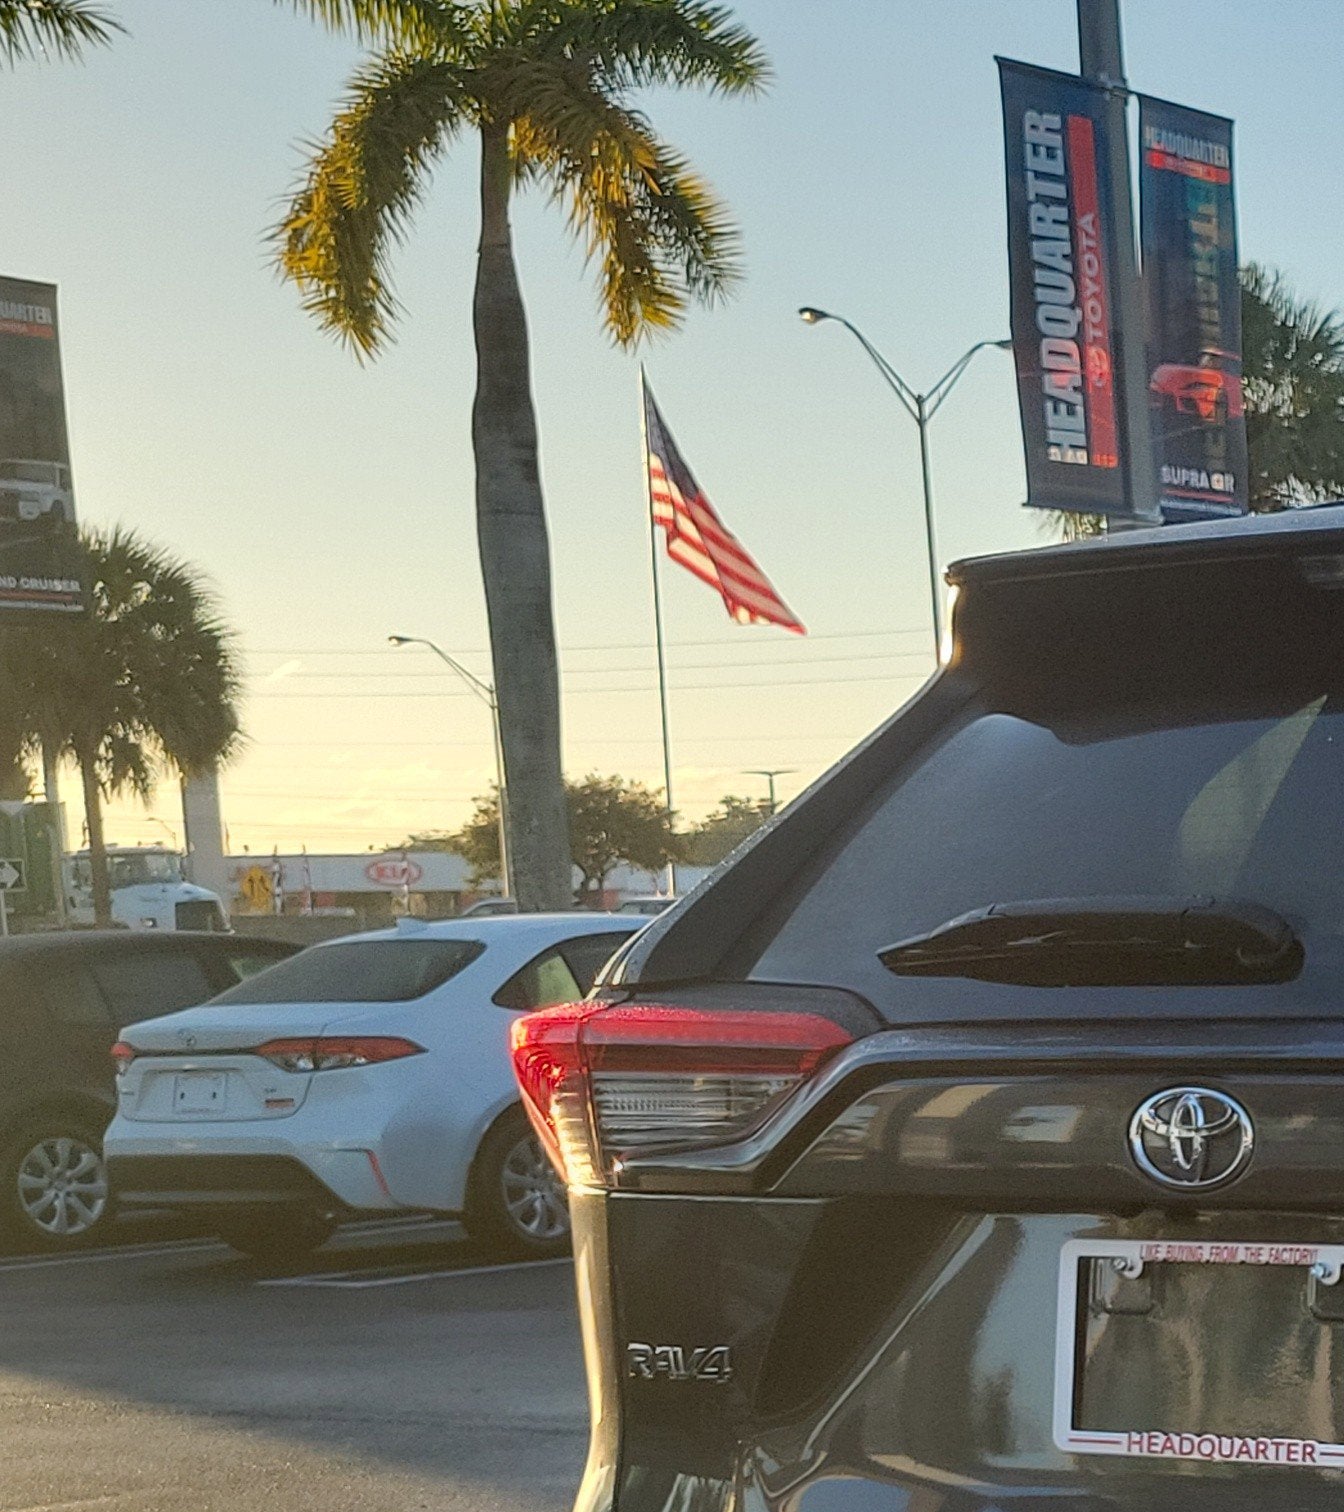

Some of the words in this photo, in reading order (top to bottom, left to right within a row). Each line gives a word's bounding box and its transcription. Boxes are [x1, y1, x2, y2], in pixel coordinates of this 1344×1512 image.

[1145, 124, 1230, 169] HEADQUARTER
[1024, 110, 1088, 465] HEADQUARTER
[1078, 213, 1104, 343] TOYOTA
[1161, 464, 1210, 489] SUPRA
[20, 577, 81, 592] CRUISER
[1140, 1244, 1161, 1260] LIKE
[1166, 1244, 1204, 1262] BUYING
[1210, 1245, 1239, 1262] FROM
[1244, 1246, 1264, 1262] THE
[628, 1343, 732, 1383] RAV4
[1127, 1431, 1317, 1463] HEADQUARTER
